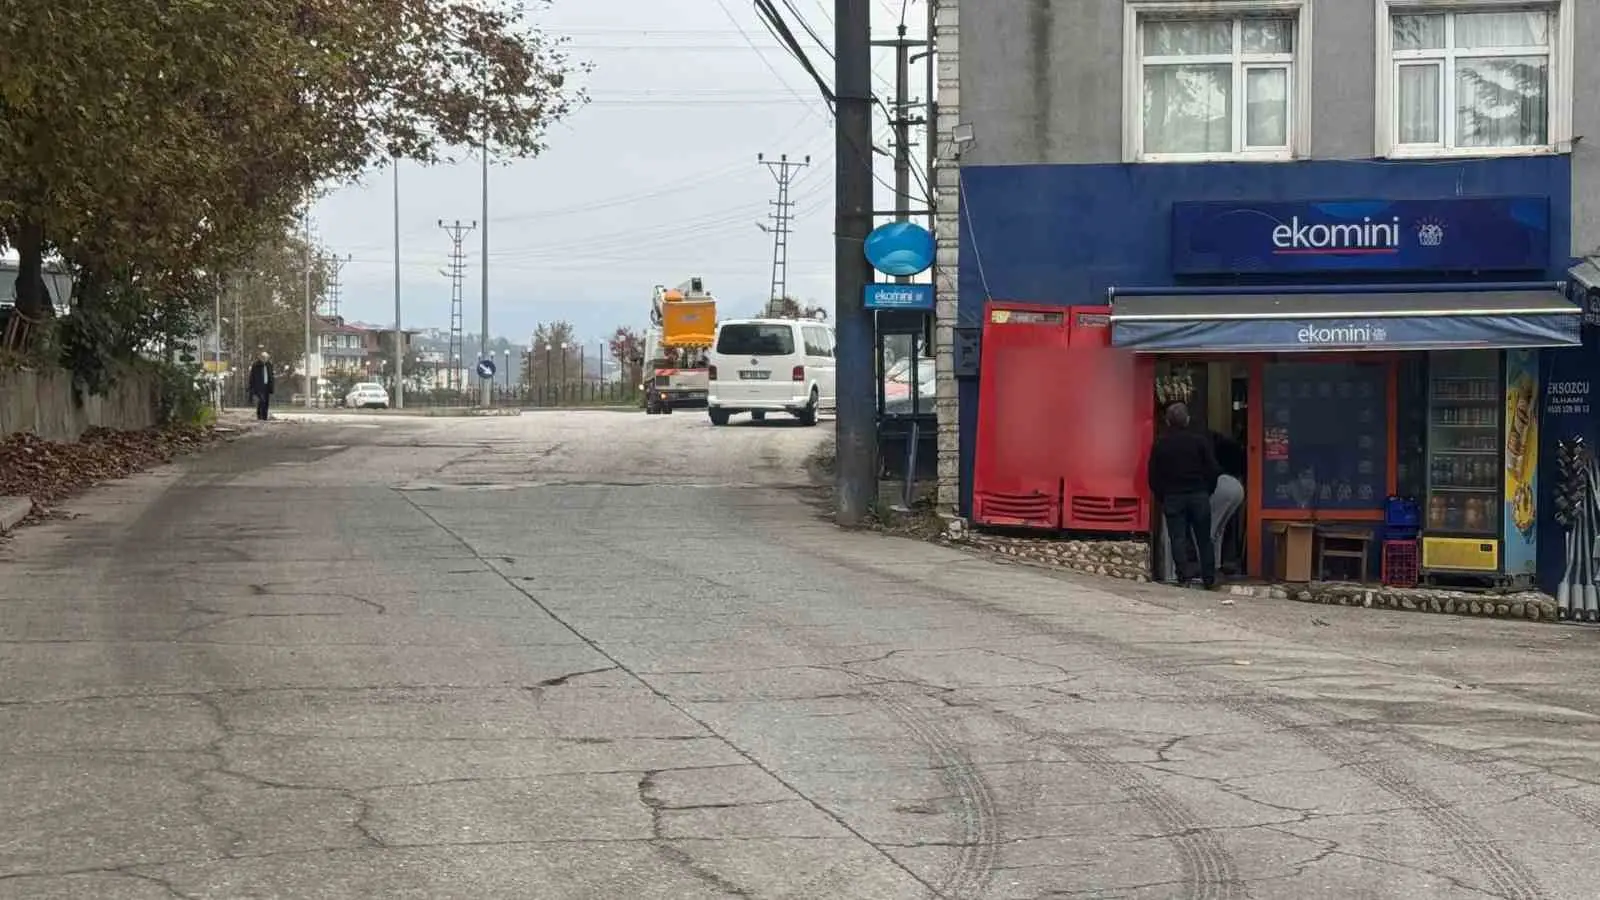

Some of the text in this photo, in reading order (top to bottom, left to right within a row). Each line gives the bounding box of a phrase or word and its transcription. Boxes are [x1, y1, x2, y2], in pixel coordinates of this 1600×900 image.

[1272, 216, 1400, 248] ekomini
[874, 289, 914, 302] ekomini
[1297, 324, 1371, 342] ekomini
